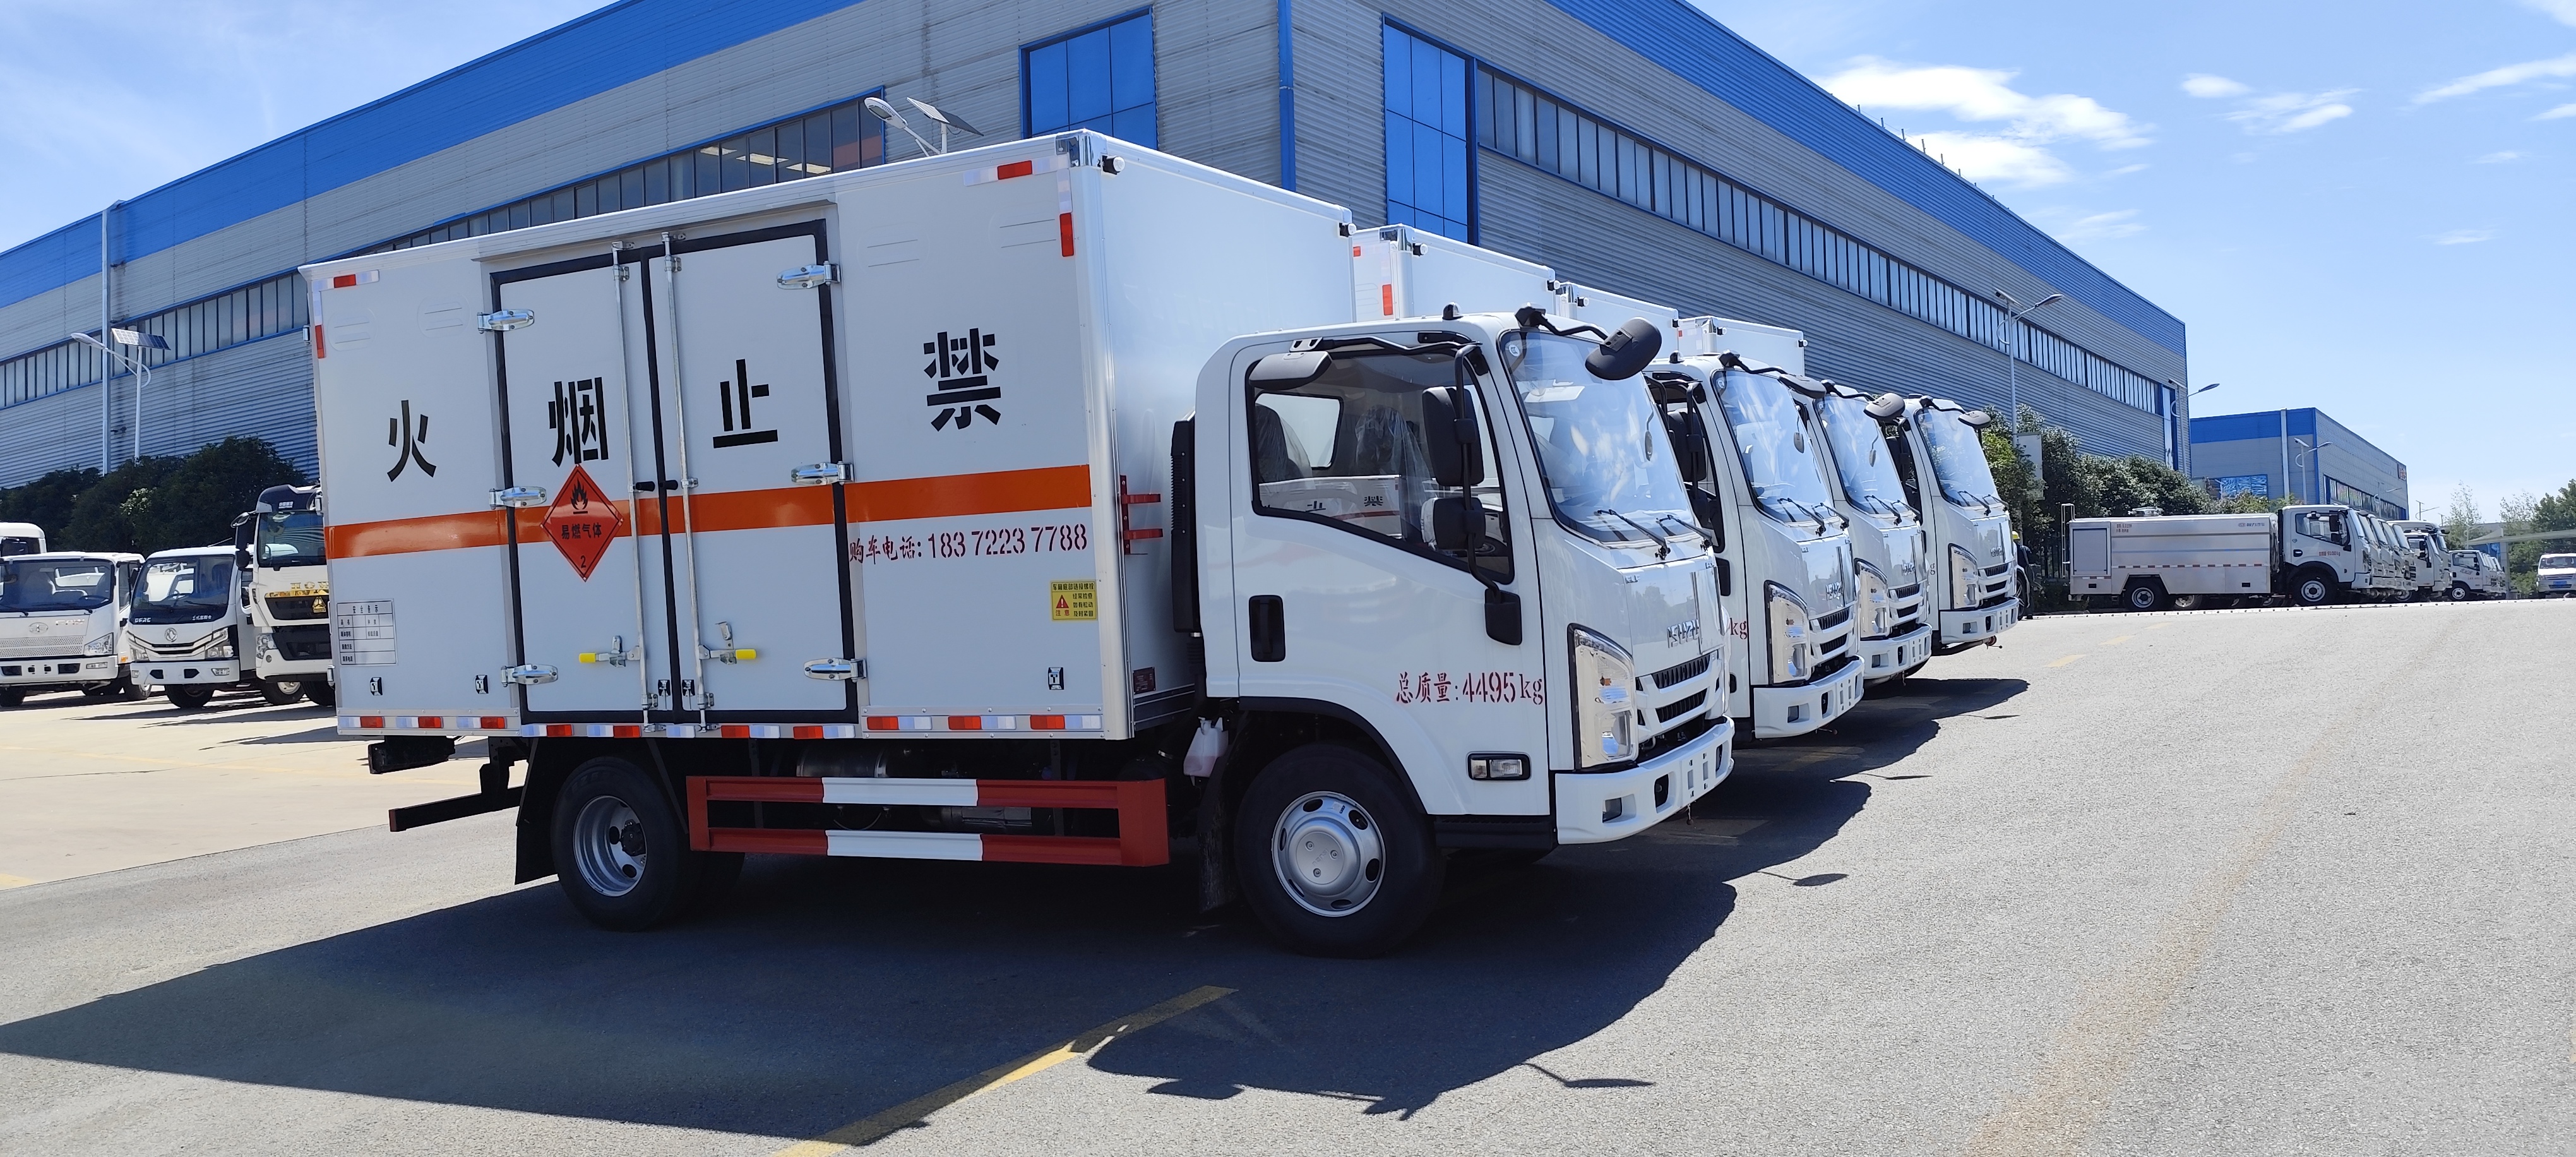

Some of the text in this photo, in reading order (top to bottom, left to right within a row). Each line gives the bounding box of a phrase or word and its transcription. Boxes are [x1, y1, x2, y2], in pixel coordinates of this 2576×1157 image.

[387, 328, 1001, 482] 火 烟 止 禁
[561, 522, 602, 539] 易燃气体
[580, 555, 587, 568] 2
